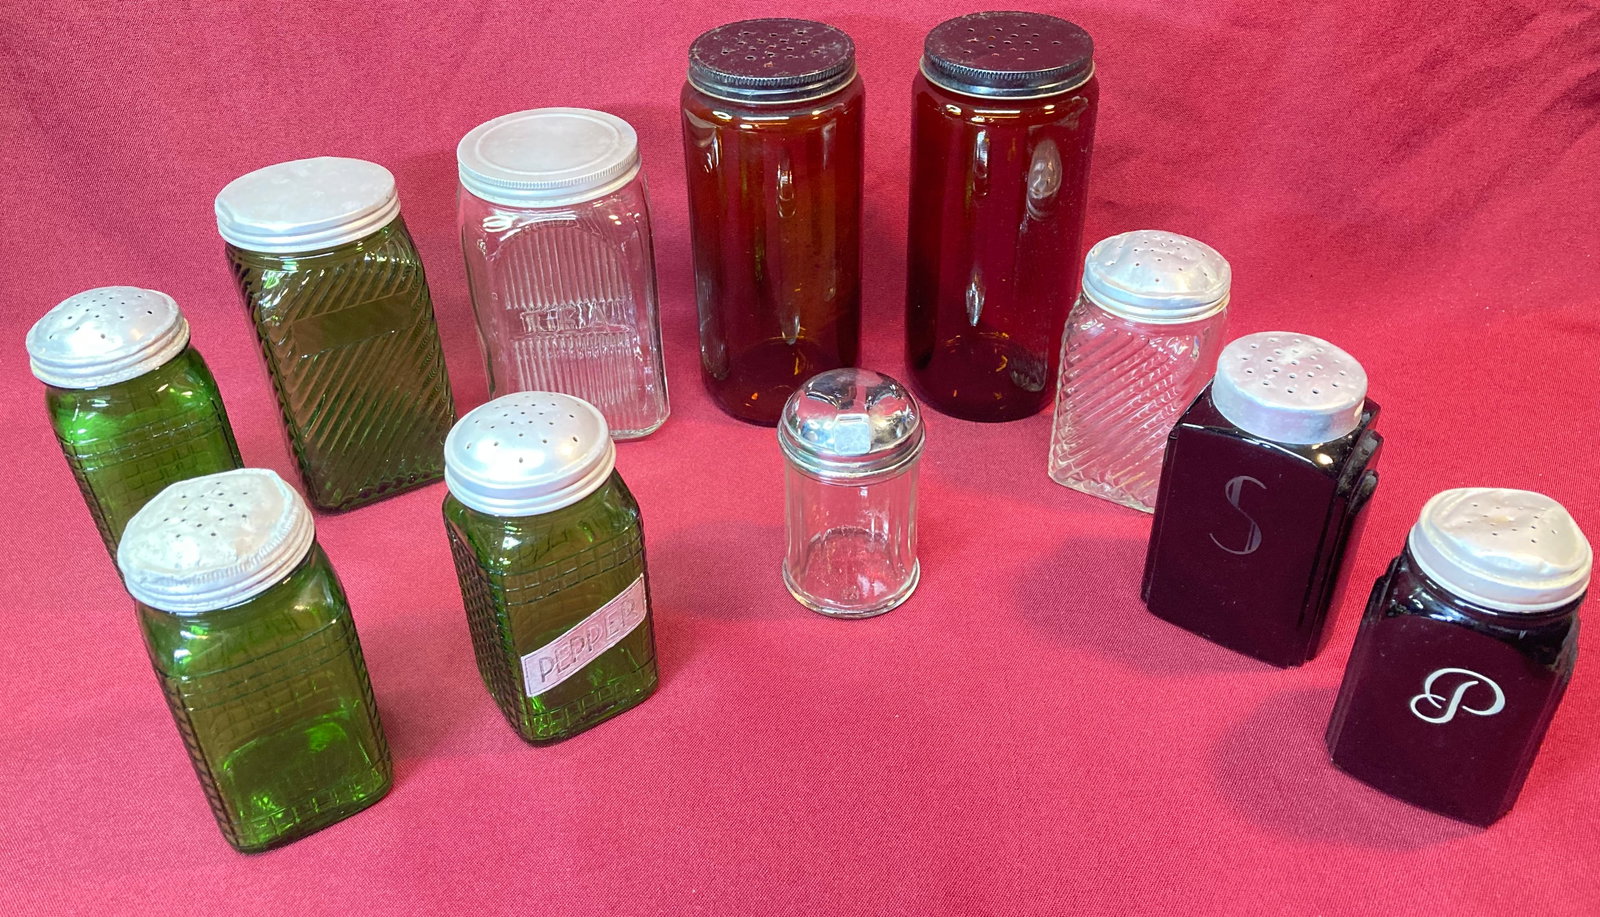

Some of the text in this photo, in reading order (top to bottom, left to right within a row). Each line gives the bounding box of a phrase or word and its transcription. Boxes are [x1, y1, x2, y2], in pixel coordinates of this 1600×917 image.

[1209, 475, 1267, 555] S
[538, 597, 639, 683] PEPPER
[1410, 667, 1506, 724] P
